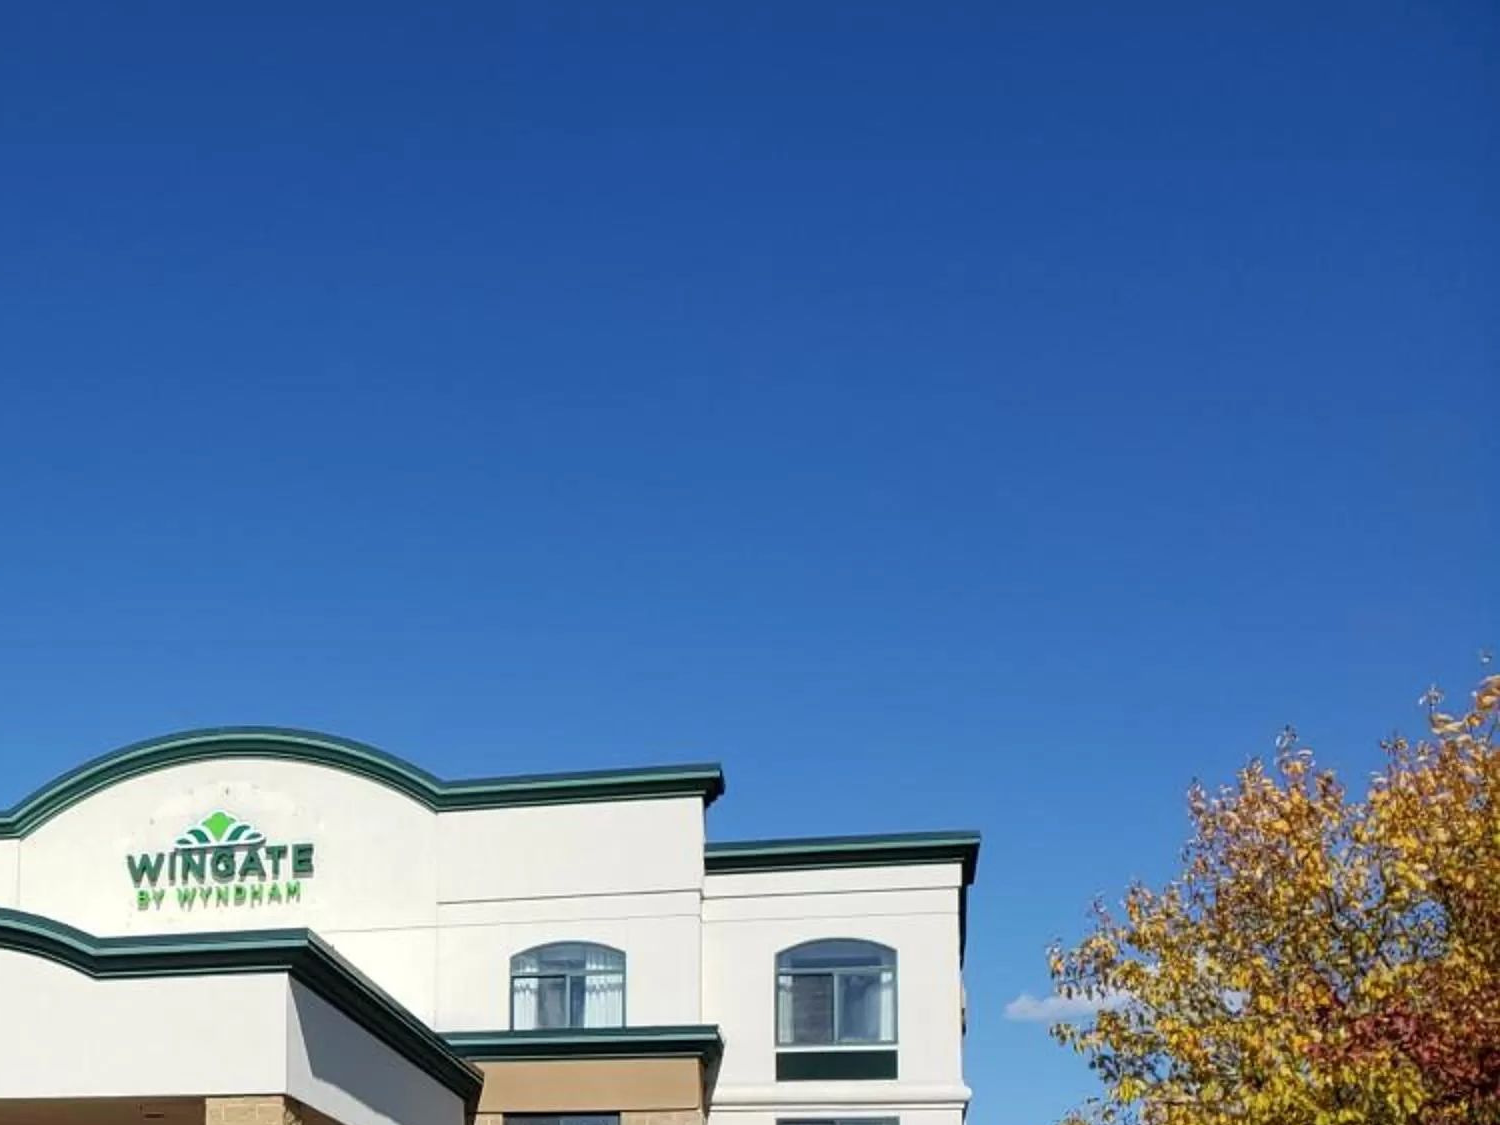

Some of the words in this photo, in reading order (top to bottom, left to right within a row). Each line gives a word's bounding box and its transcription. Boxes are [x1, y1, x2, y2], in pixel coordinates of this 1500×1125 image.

[126, 844, 314, 886] WINGATE
[136, 889, 165, 910] BY
[177, 880, 302, 910] WYNDHAM
